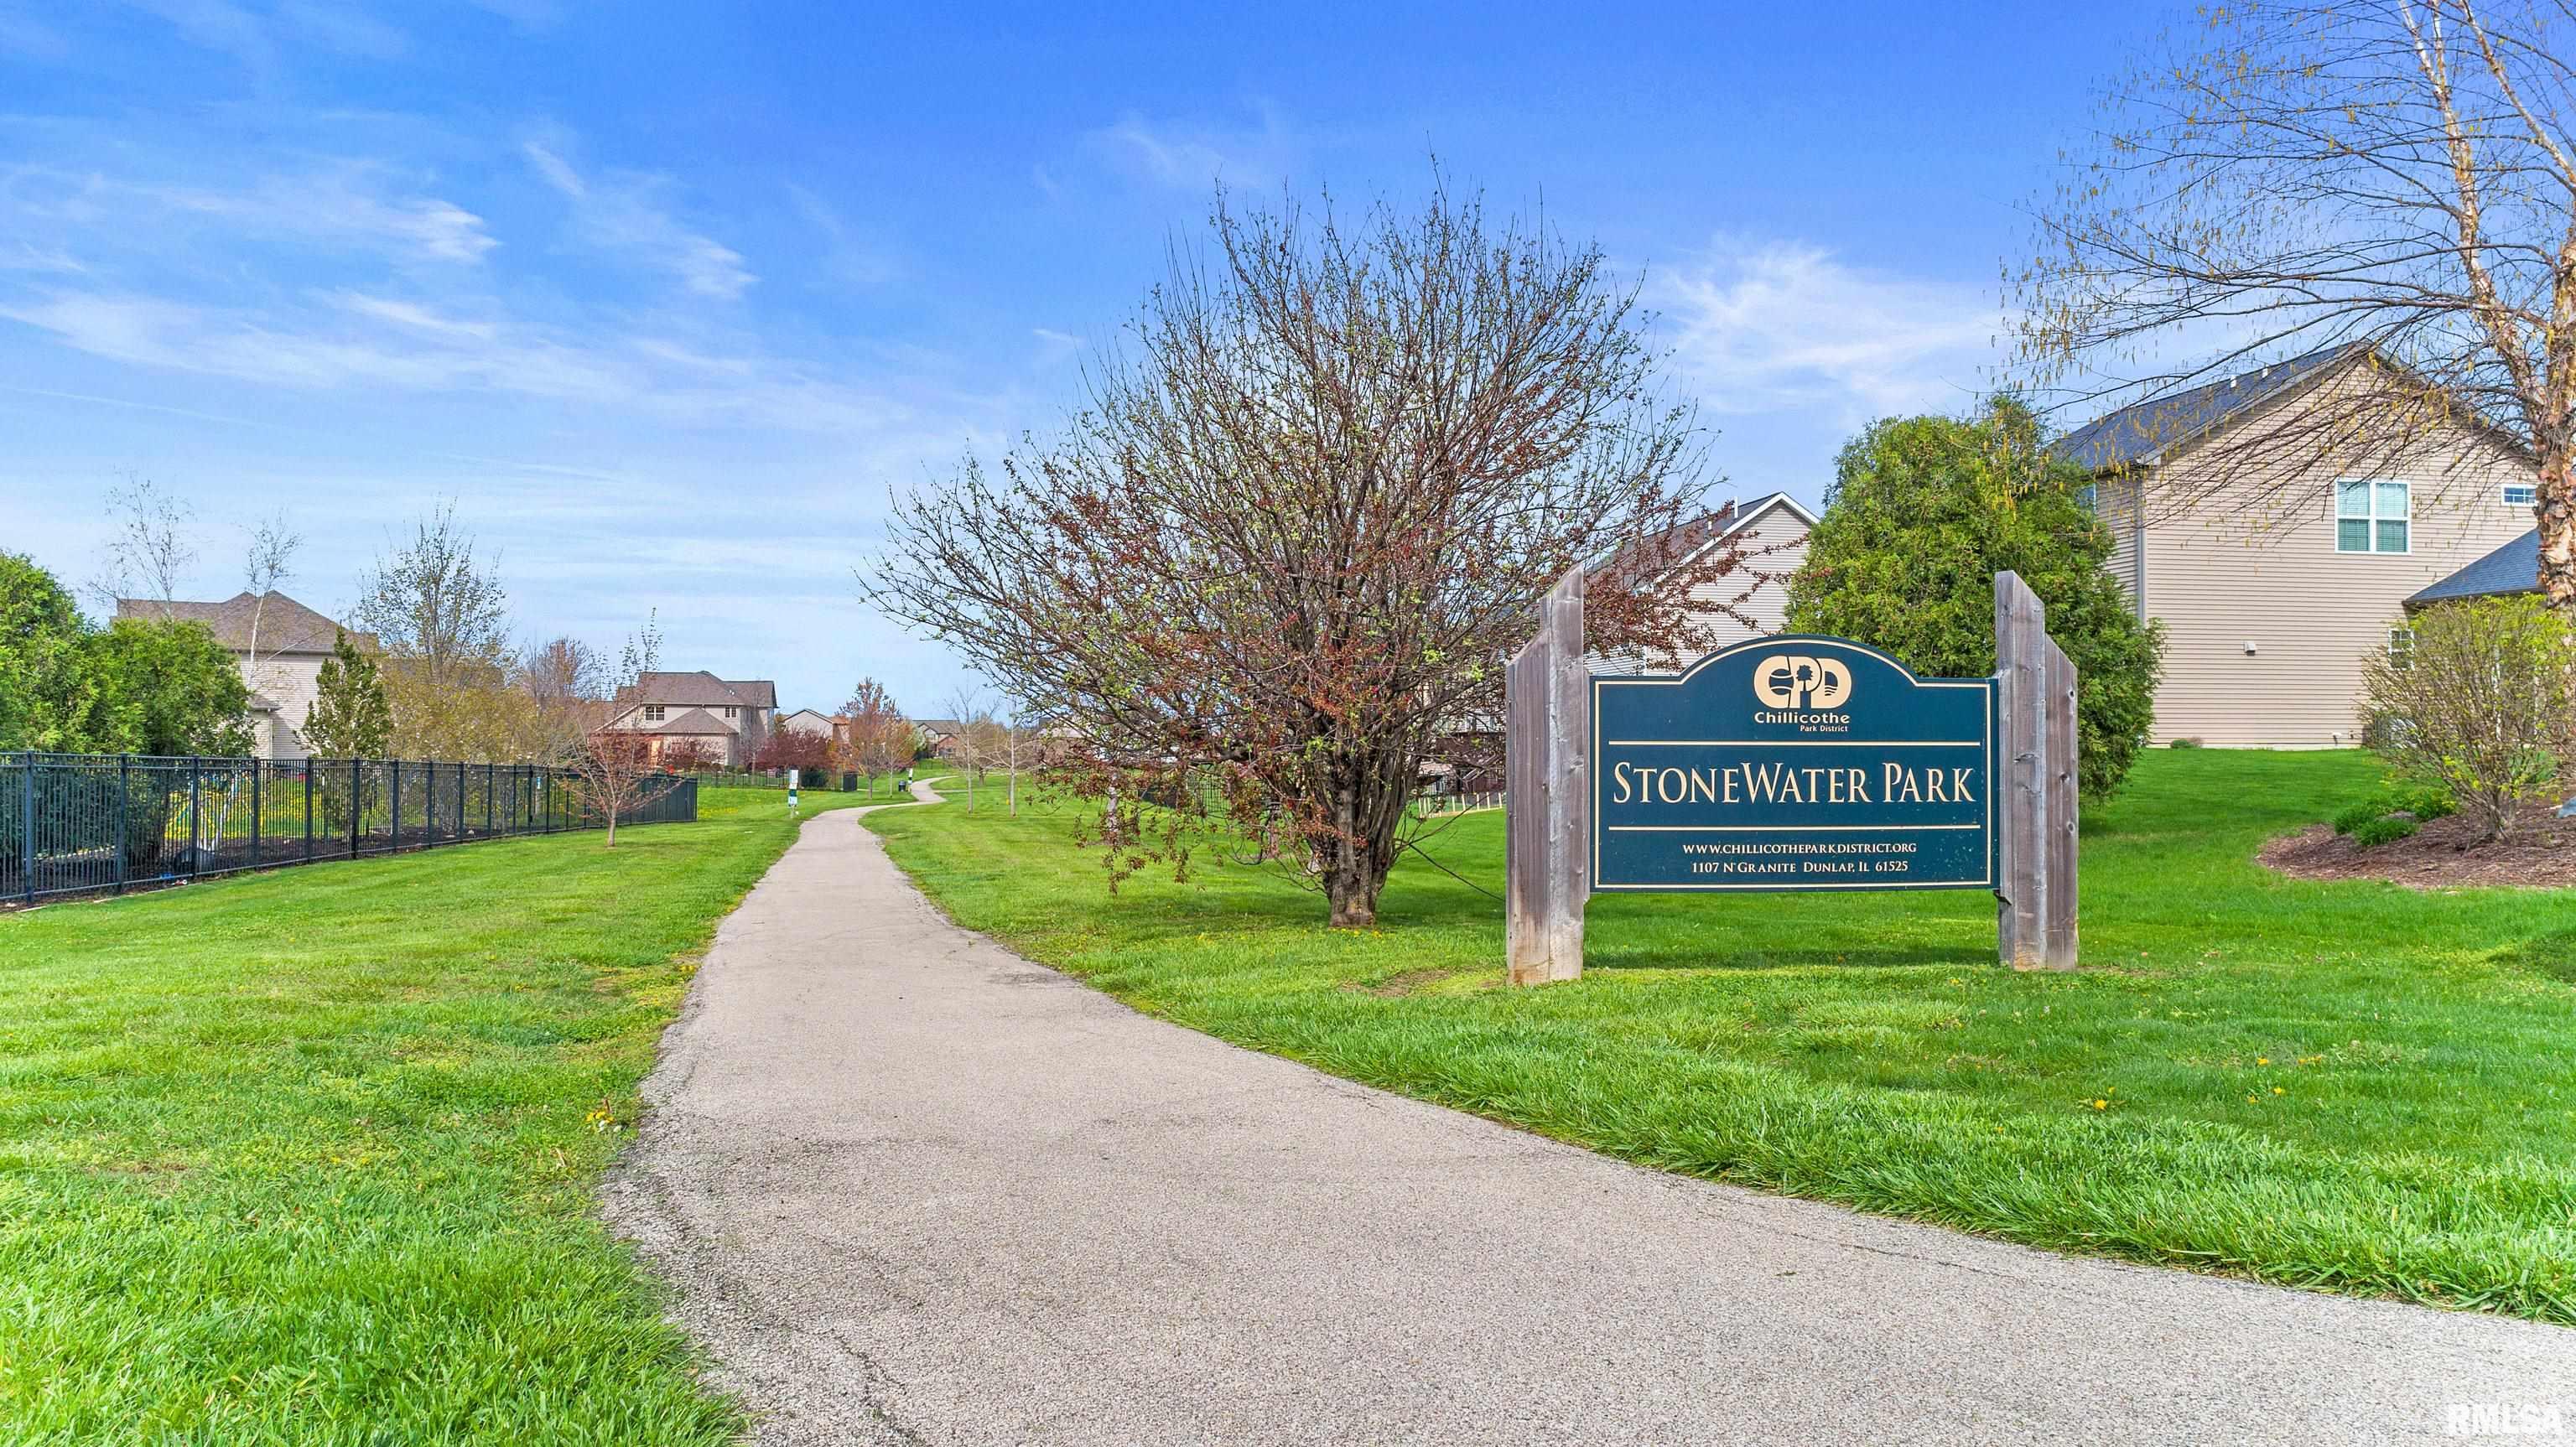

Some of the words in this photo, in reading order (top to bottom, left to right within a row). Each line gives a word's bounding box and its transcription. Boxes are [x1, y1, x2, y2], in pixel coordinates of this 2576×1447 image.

[1754, 656, 1852, 708] CPD
[1754, 711, 1851, 724] Chillicothe
[1692, 862, 1720, 873] 1107
[1875, 860, 1909, 872] 61525
